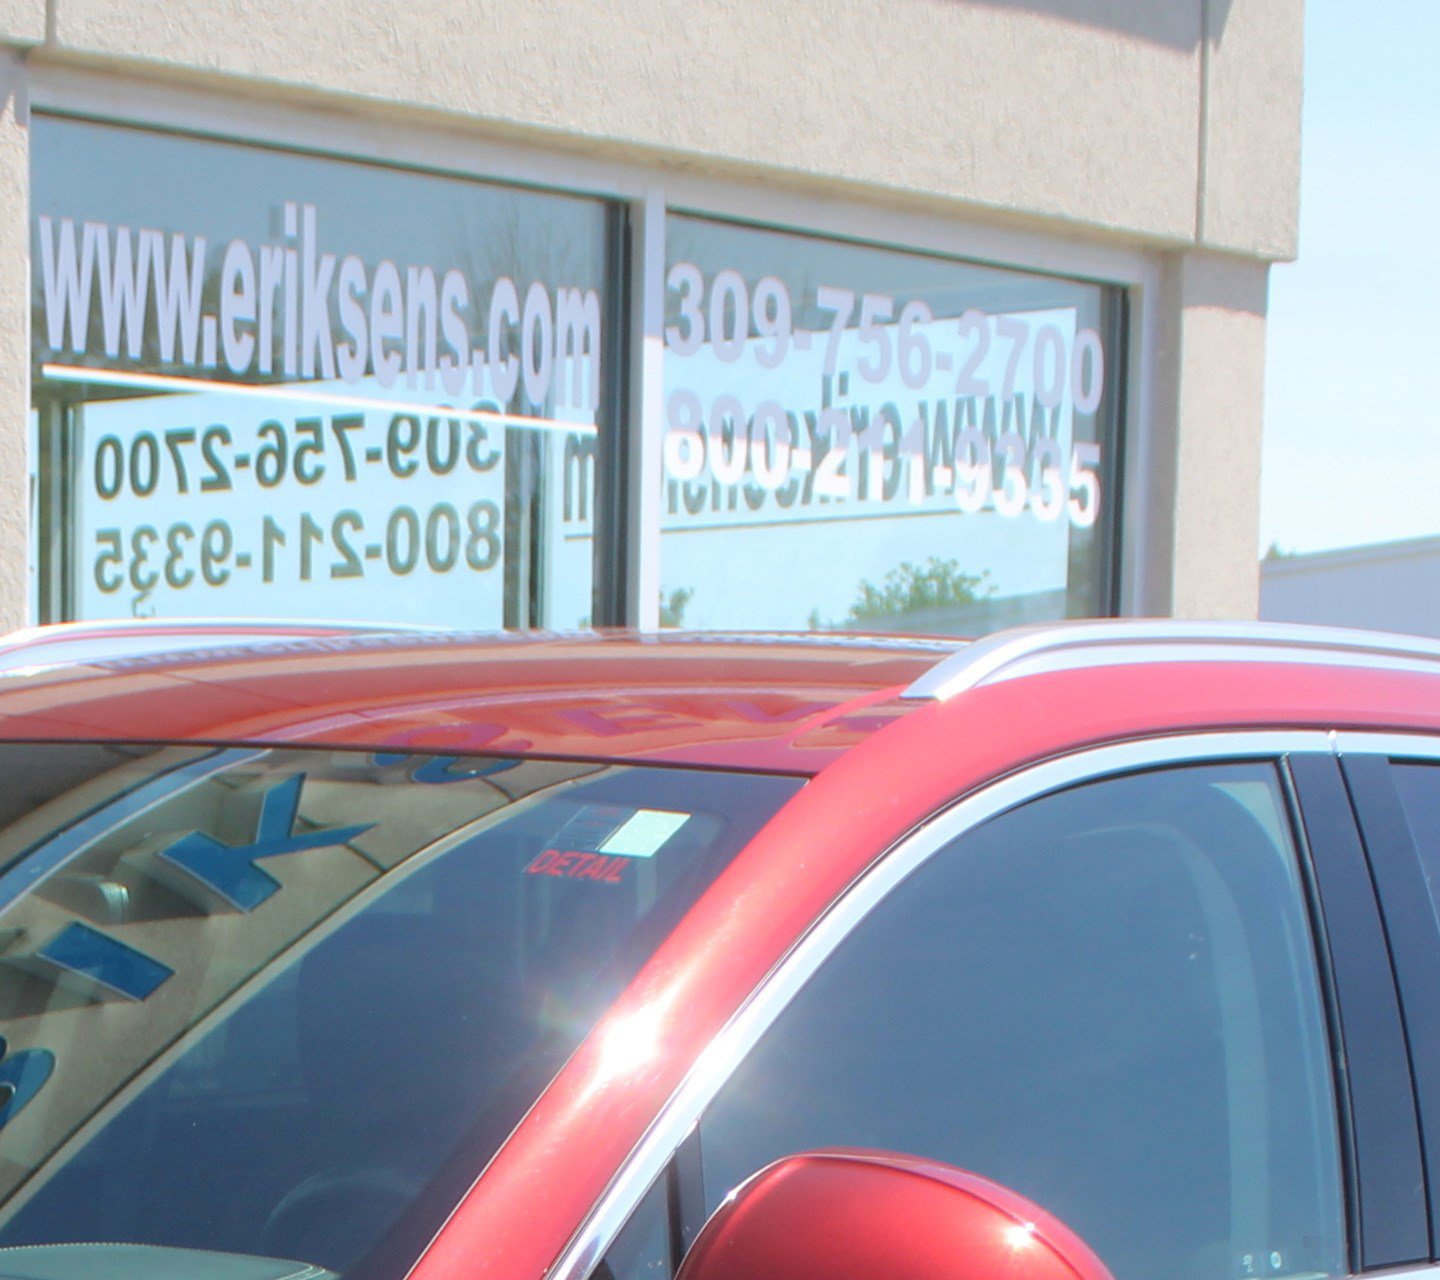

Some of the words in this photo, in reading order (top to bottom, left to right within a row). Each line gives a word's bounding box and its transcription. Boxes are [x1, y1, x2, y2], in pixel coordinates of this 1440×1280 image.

[38, 202, 601, 412] www.eriksens.com
[664, 262, 1105, 416] 309-756-2700
[663, 387, 1102, 529] 800-211-9335
[526, 849, 632, 883] DETAIL
